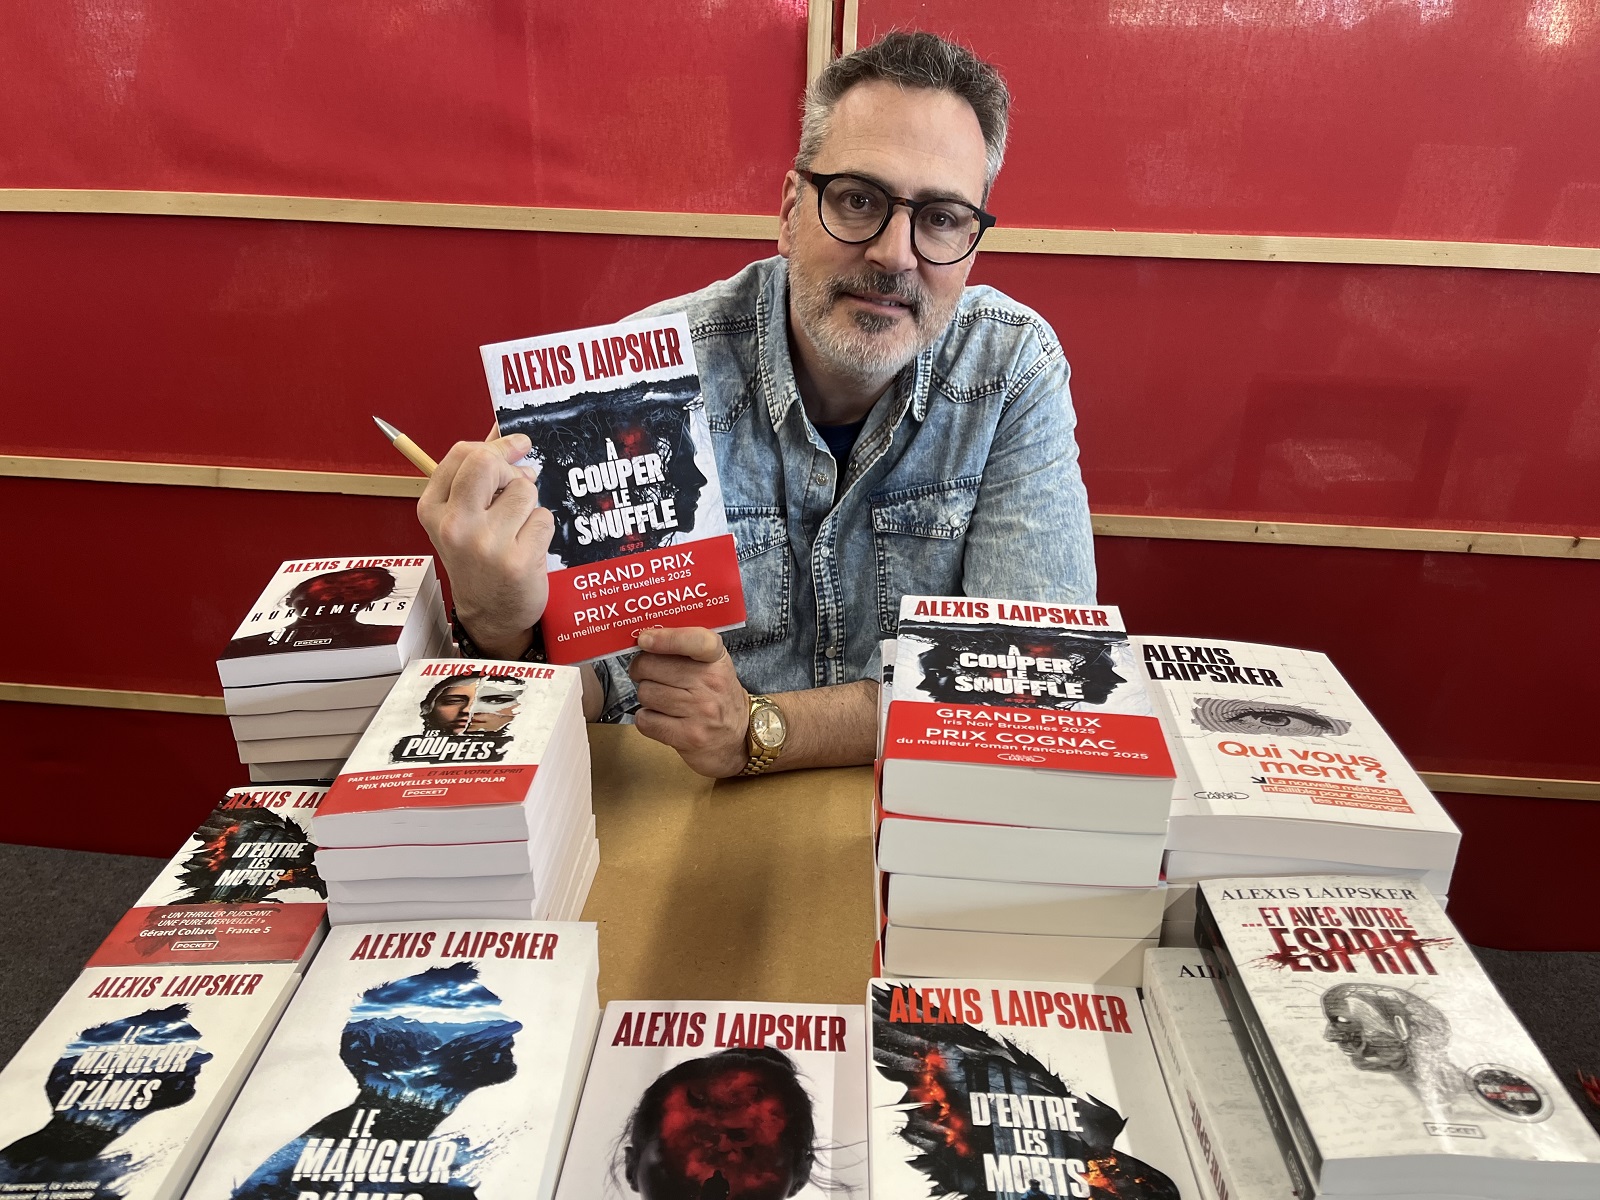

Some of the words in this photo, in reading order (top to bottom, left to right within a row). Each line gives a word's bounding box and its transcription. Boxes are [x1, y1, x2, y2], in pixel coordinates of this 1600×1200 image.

[501, 344, 576, 395] ALEXIS
[578, 327, 684, 380] LAIPSKER
[605, 437, 618, 460] À
[568, 452, 665, 497] COUPER
[612, 490, 631, 509] LE
[575, 498, 679, 546] SOUFFLE
[283, 560, 341, 574] ALEXIS
[345, 557, 425, 570] LAIPSKER
[573, 563, 645, 591] GRAND
[650, 551, 695, 574] PRIX
[582, 590, 597, 601] Iris
[600, 585, 620, 597] Noir
[622, 575, 666, 592] Bruxelles
[668, 569, 692, 582] 2025
[250, 600, 408, 623] HURLEMENTS
[573, 602, 620, 627] PRIX
[624, 582, 709, 613] COGNAC
[914, 600, 990, 619] ALEXIS
[997, 603, 1110, 627] LAIPSKER
[557, 633, 570, 643] du
[572, 623, 611, 639] meilleur
[613, 615, 643, 629] roman
[645, 601, 704, 621] francophone
[706, 594, 730, 607] 2025
[959, 652, 1073, 675] COUPER
[1142, 644, 1236, 666] ALEXIS
[420, 663, 477, 677] ALEXIS
[479, 664, 556, 680] LAIPSKER
[1006, 669, 1029, 681] LE
[1144, 661, 1284, 688] LAIPSKER
[954, 675, 1085, 700] SOUFFLE
[936, 708, 1031, 723] GRAND
[1041, 714, 1102, 728] PRIX
[965, 720, 993, 728] Noir
[998, 722, 1058, 733] Bruxelles
[1061, 726, 1096, 735] 2025
[425, 729, 441, 738] LES
[925, 727, 987, 742] PRIX
[995, 732, 1118, 751] COGNAC
[401, 736, 496, 761] POUPÉES
[896, 736, 914, 745] du
[916, 737, 972, 748] meilleur
[974, 742, 1018, 750] roman
[1022, 744, 1109, 758] francophone
[1113, 752, 1149, 761] 2025
[1217, 740, 1283, 759] Qui
[1288, 747, 1383, 769] vous
[365, 773, 401, 781] L'AUTEUR
[1259, 760, 1361, 781] ment
[1363, 766, 1388, 784] ?
[356, 783, 378, 791] PRIX
[380, 779, 432, 789] NOUVELLES
[1262, 784, 1317, 796] infaillible
[1318, 790, 1350, 800] pour
[1350, 791, 1405, 804] détecter
[1270, 777, 1287, 786] La
[1288, 779, 1341, 790] nouvelle
[1341, 784, 1399, 797] méthode
[221, 791, 292, 810] ALEXIS
[1313, 796, 1332, 805] les
[1333, 799, 1411, 813] mensonges
[231, 842, 308, 858] D'ENTRE
[248, 857, 274, 869] LES
[214, 869, 286, 886] MORTS
[1221, 888, 1300, 901] ALEXIS
[1307, 887, 1419, 901] LAIPSKER
[183, 910, 225, 919] THRILLER
[1290, 907, 1342, 928] AVEC
[1345, 907, 1414, 929] VOTRE
[139, 928, 177, 937] Gérard
[177, 927, 217, 936] Collard
[225, 927, 261, 935] France
[263, 926, 272, 934] 5
[349, 931, 437, 961] ALEXIS
[440, 931, 559, 961] LAIPSKER
[1269, 927, 1439, 976] ESPRIT
[87, 976, 164, 999] ALEXIS
[160, 973, 264, 998] LAIPSKER
[888, 987, 984, 1025] ALEXIS
[993, 988, 1133, 1035] LAIPSKER
[121, 1025, 146, 1045] LE
[611, 1011, 707, 1049] ALEXIS
[713, 1012, 847, 1053] LAIPSKER
[70, 1044, 198, 1076] MANGEUR
[54, 1074, 162, 1111] D'ÂMES
[348, 1109, 381, 1138] LE
[969, 1091, 1084, 1132] D'ENTRE
[1013, 1129, 1048, 1156] LES
[291, 1138, 458, 1184] MANGEUR
[983, 1153, 1091, 1198] MORTS
